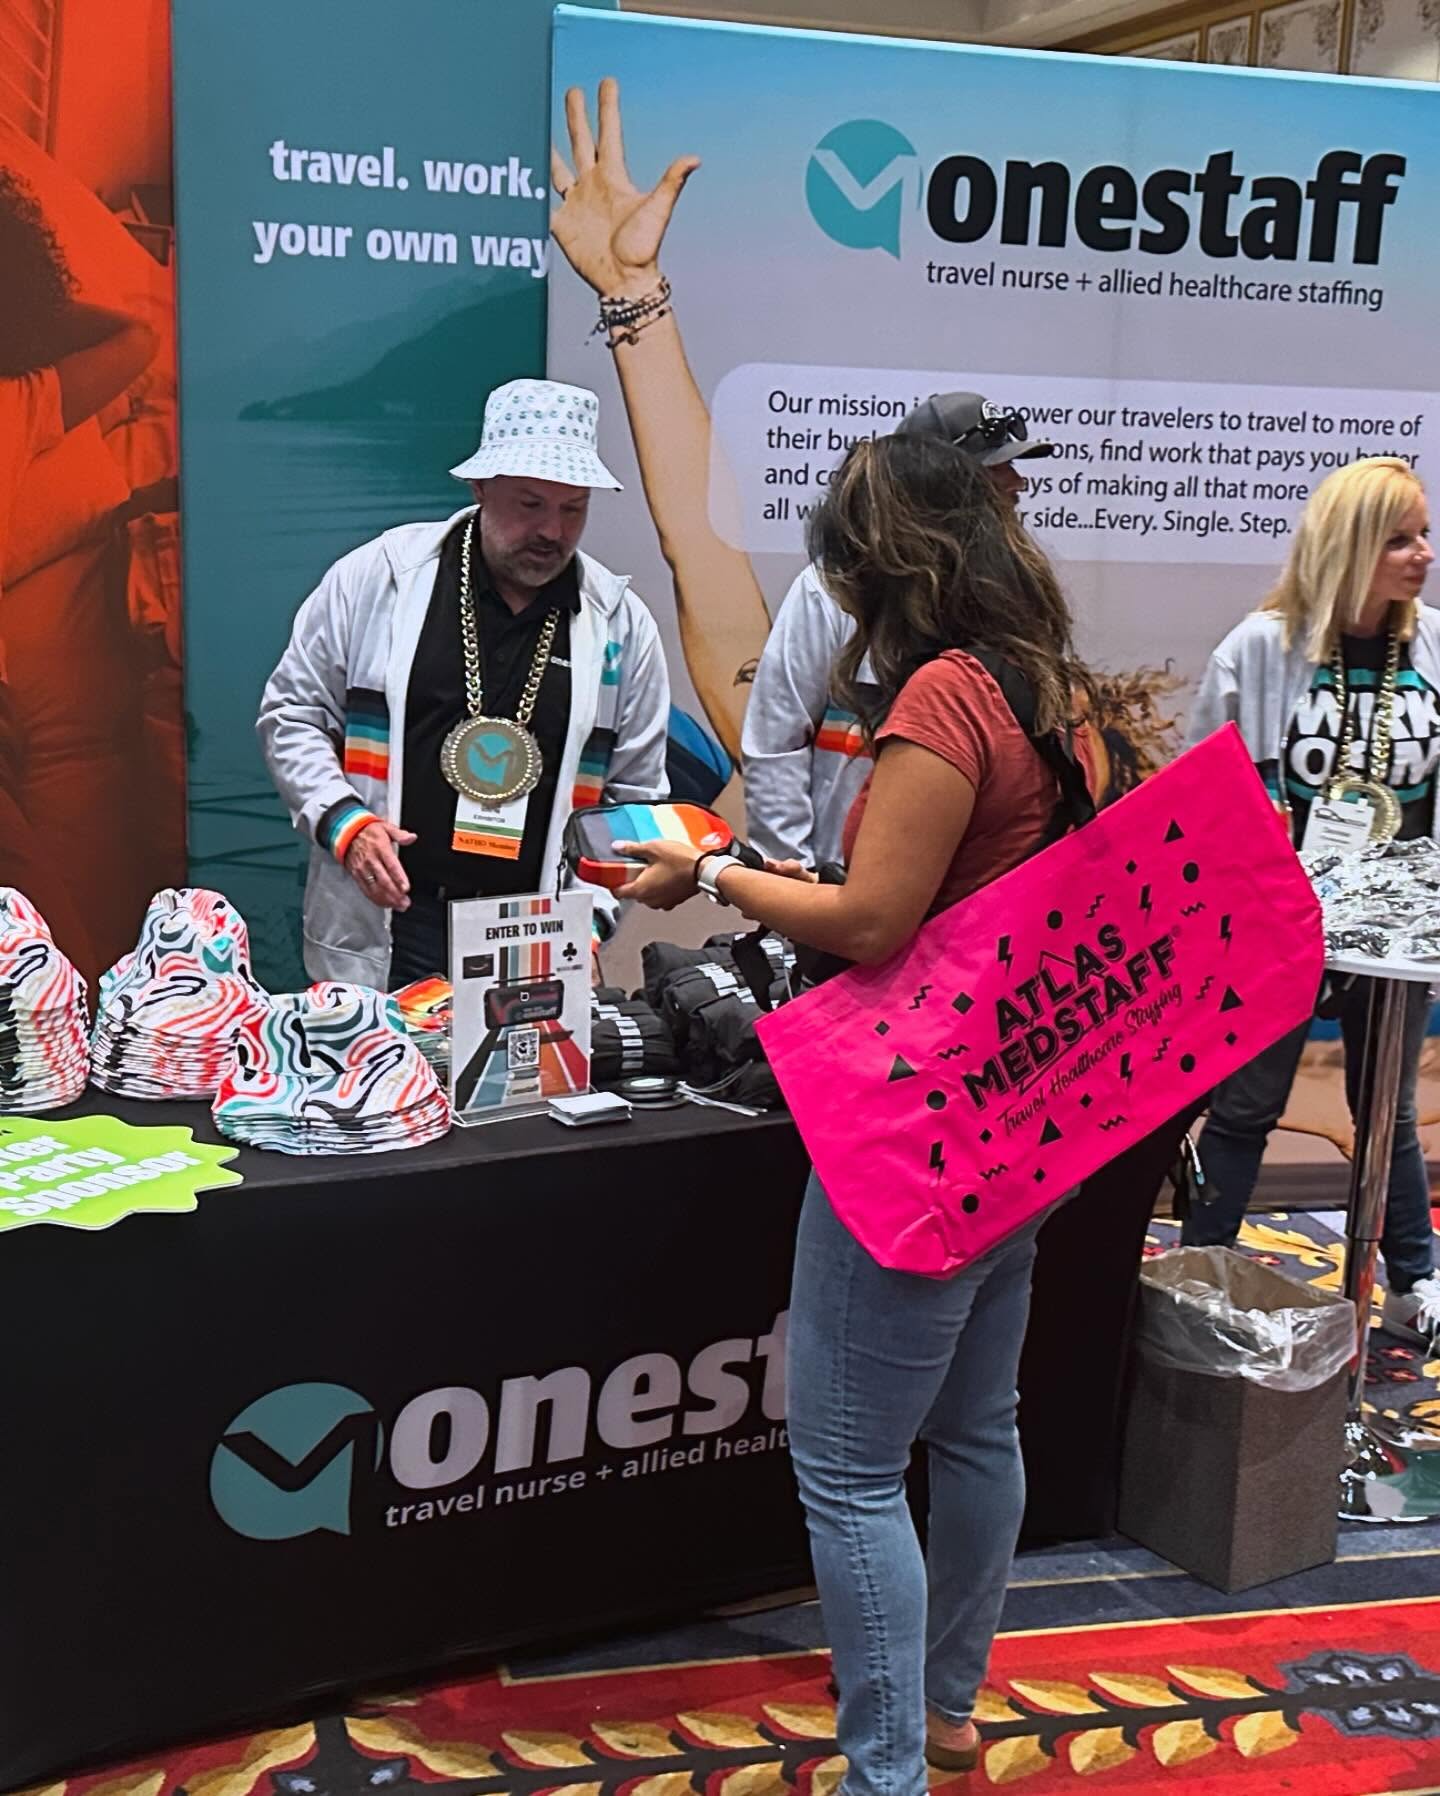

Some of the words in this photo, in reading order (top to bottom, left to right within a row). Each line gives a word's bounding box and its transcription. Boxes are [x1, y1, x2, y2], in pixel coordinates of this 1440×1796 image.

[269, 140, 409, 190] travel.
[423, 157, 546, 199] work.
[927, 150, 1407, 265] onestaff
[252, 222, 352, 263] your
[366, 228, 457, 264] own
[471, 235, 549, 278] way
[926, 261, 995, 286] travel
[1002, 269, 1069, 290] nurse
[1098, 269, 1163, 295] allied
[1169, 272, 1292, 301] healthcare
[1298, 281, 1384, 312] staffing
[768, 390, 813, 414] Our
[818, 393, 906, 417] mission
[1078, 408, 1117, 427] our
[1121, 407, 1213, 430] travelers
[1219, 413, 1242, 432] to
[1248, 411, 1307, 434] travel
[1312, 415, 1334, 434] to
[1340, 420, 1393, 437] more
[1400, 415, 1424, 437] of
[767, 427, 821, 451] their
[1100, 439, 1143, 462] find
[1149, 443, 1203, 465] work
[1208, 443, 1251, 466] that
[1256, 451, 1305, 472] pays
[1310, 451, 1350, 472] you
[765, 463, 809, 486] and
[1059, 472, 1084, 494] of
[1087, 474, 1168, 502] making
[1173, 476, 1199, 499] all
[1204, 477, 1248, 500] that
[1253, 483, 1309, 501] more
[763, 497, 789, 520] all
[1163, 510, 1235, 538] Single.
[1239, 513, 1293, 539] Step.
[486, 925, 520, 940] ENTER
[523, 923, 538, 936] TO
[541, 920, 564, 934] WIN
[994, 923, 1128, 1041] ATLAS
[961, 934, 1176, 1110] MEDSTAFF
[997, 1090, 1047, 1137] Travel
[1050, 1031, 1126, 1097] Healthcare
[1124, 983, 1183, 1035] Staffing
[0, 1150, 204, 1217] Sponsor
[389, 1310, 788, 1490] onest
[385, 1485, 485, 1528] travel
[495, 1470, 586, 1505] nurse
[621, 1441, 705, 1479] allied
[714, 1427, 790, 1461] healt
